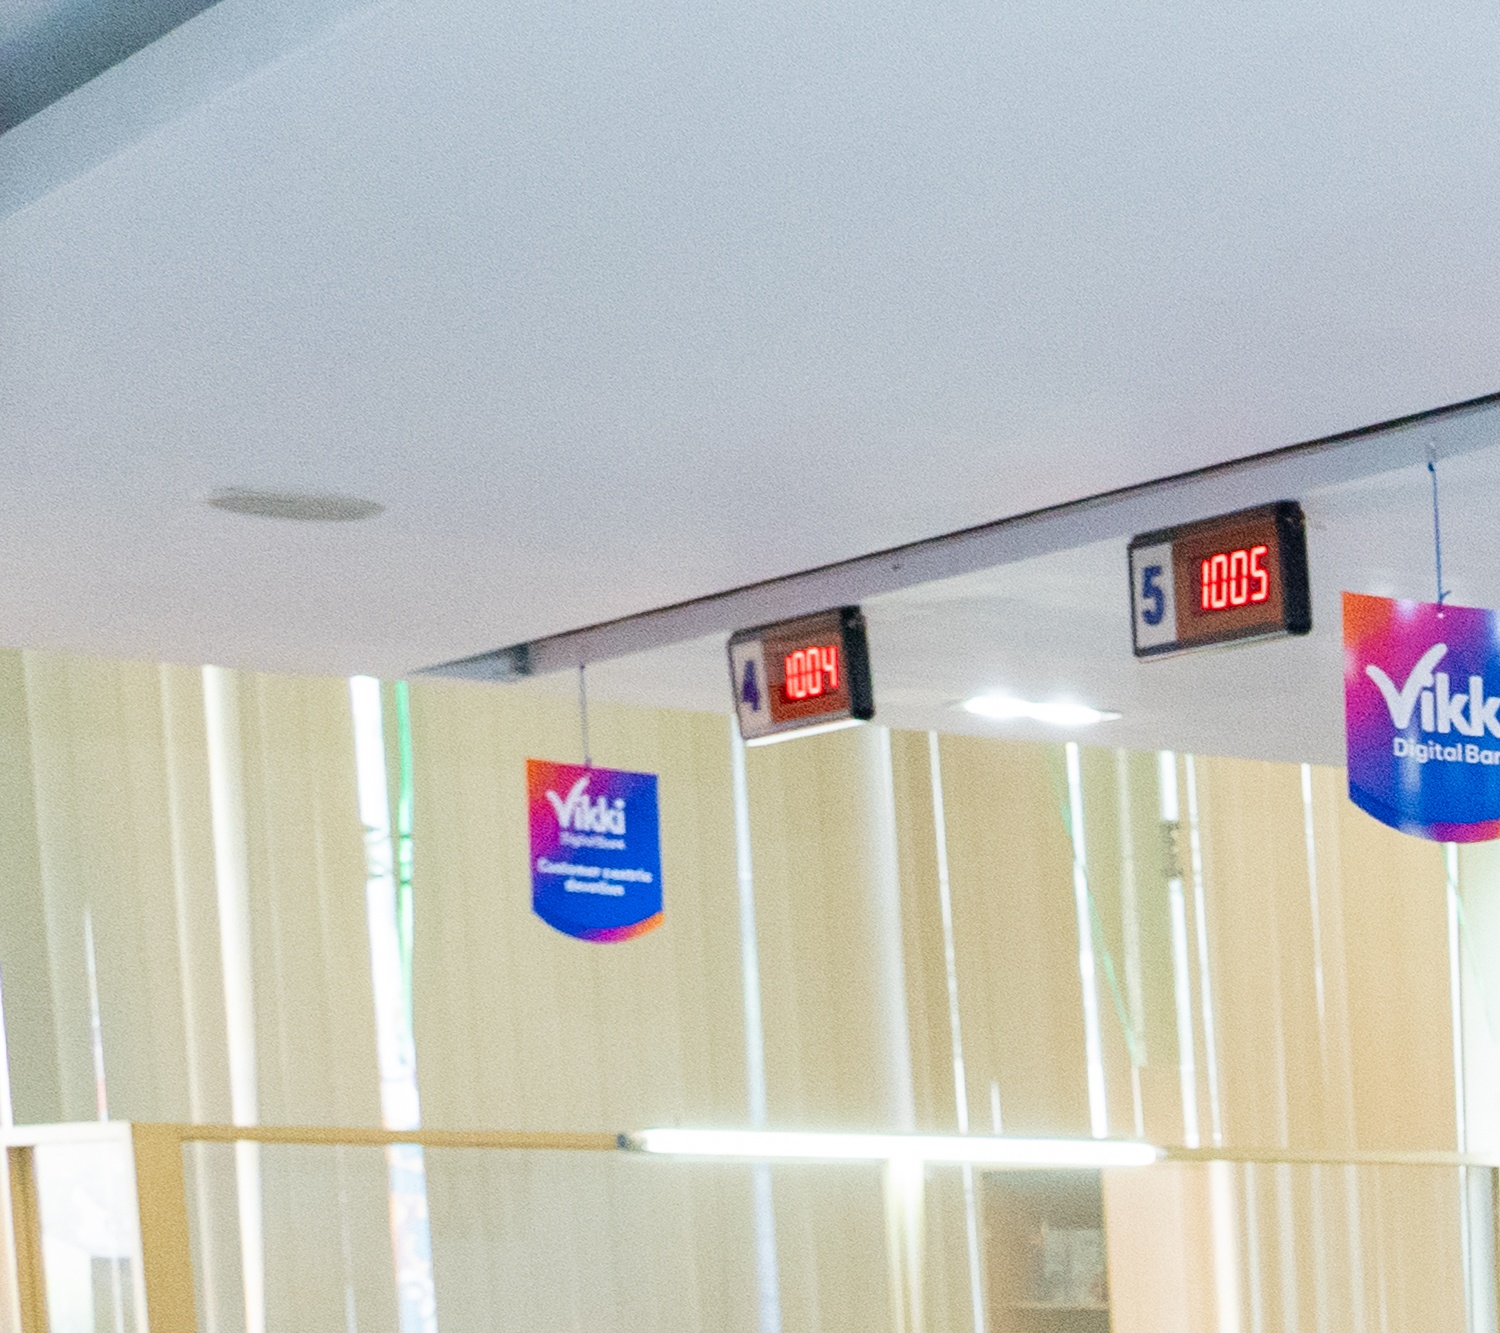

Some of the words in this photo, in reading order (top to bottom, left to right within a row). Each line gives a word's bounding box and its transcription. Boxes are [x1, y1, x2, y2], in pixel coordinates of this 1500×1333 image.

[1142, 565, 1165, 627] 5
[1200, 544, 1271, 611] 1005
[741, 659, 761, 712] 4
[785, 644, 838, 701] 1004
[545, 771, 627, 835] Vikki
